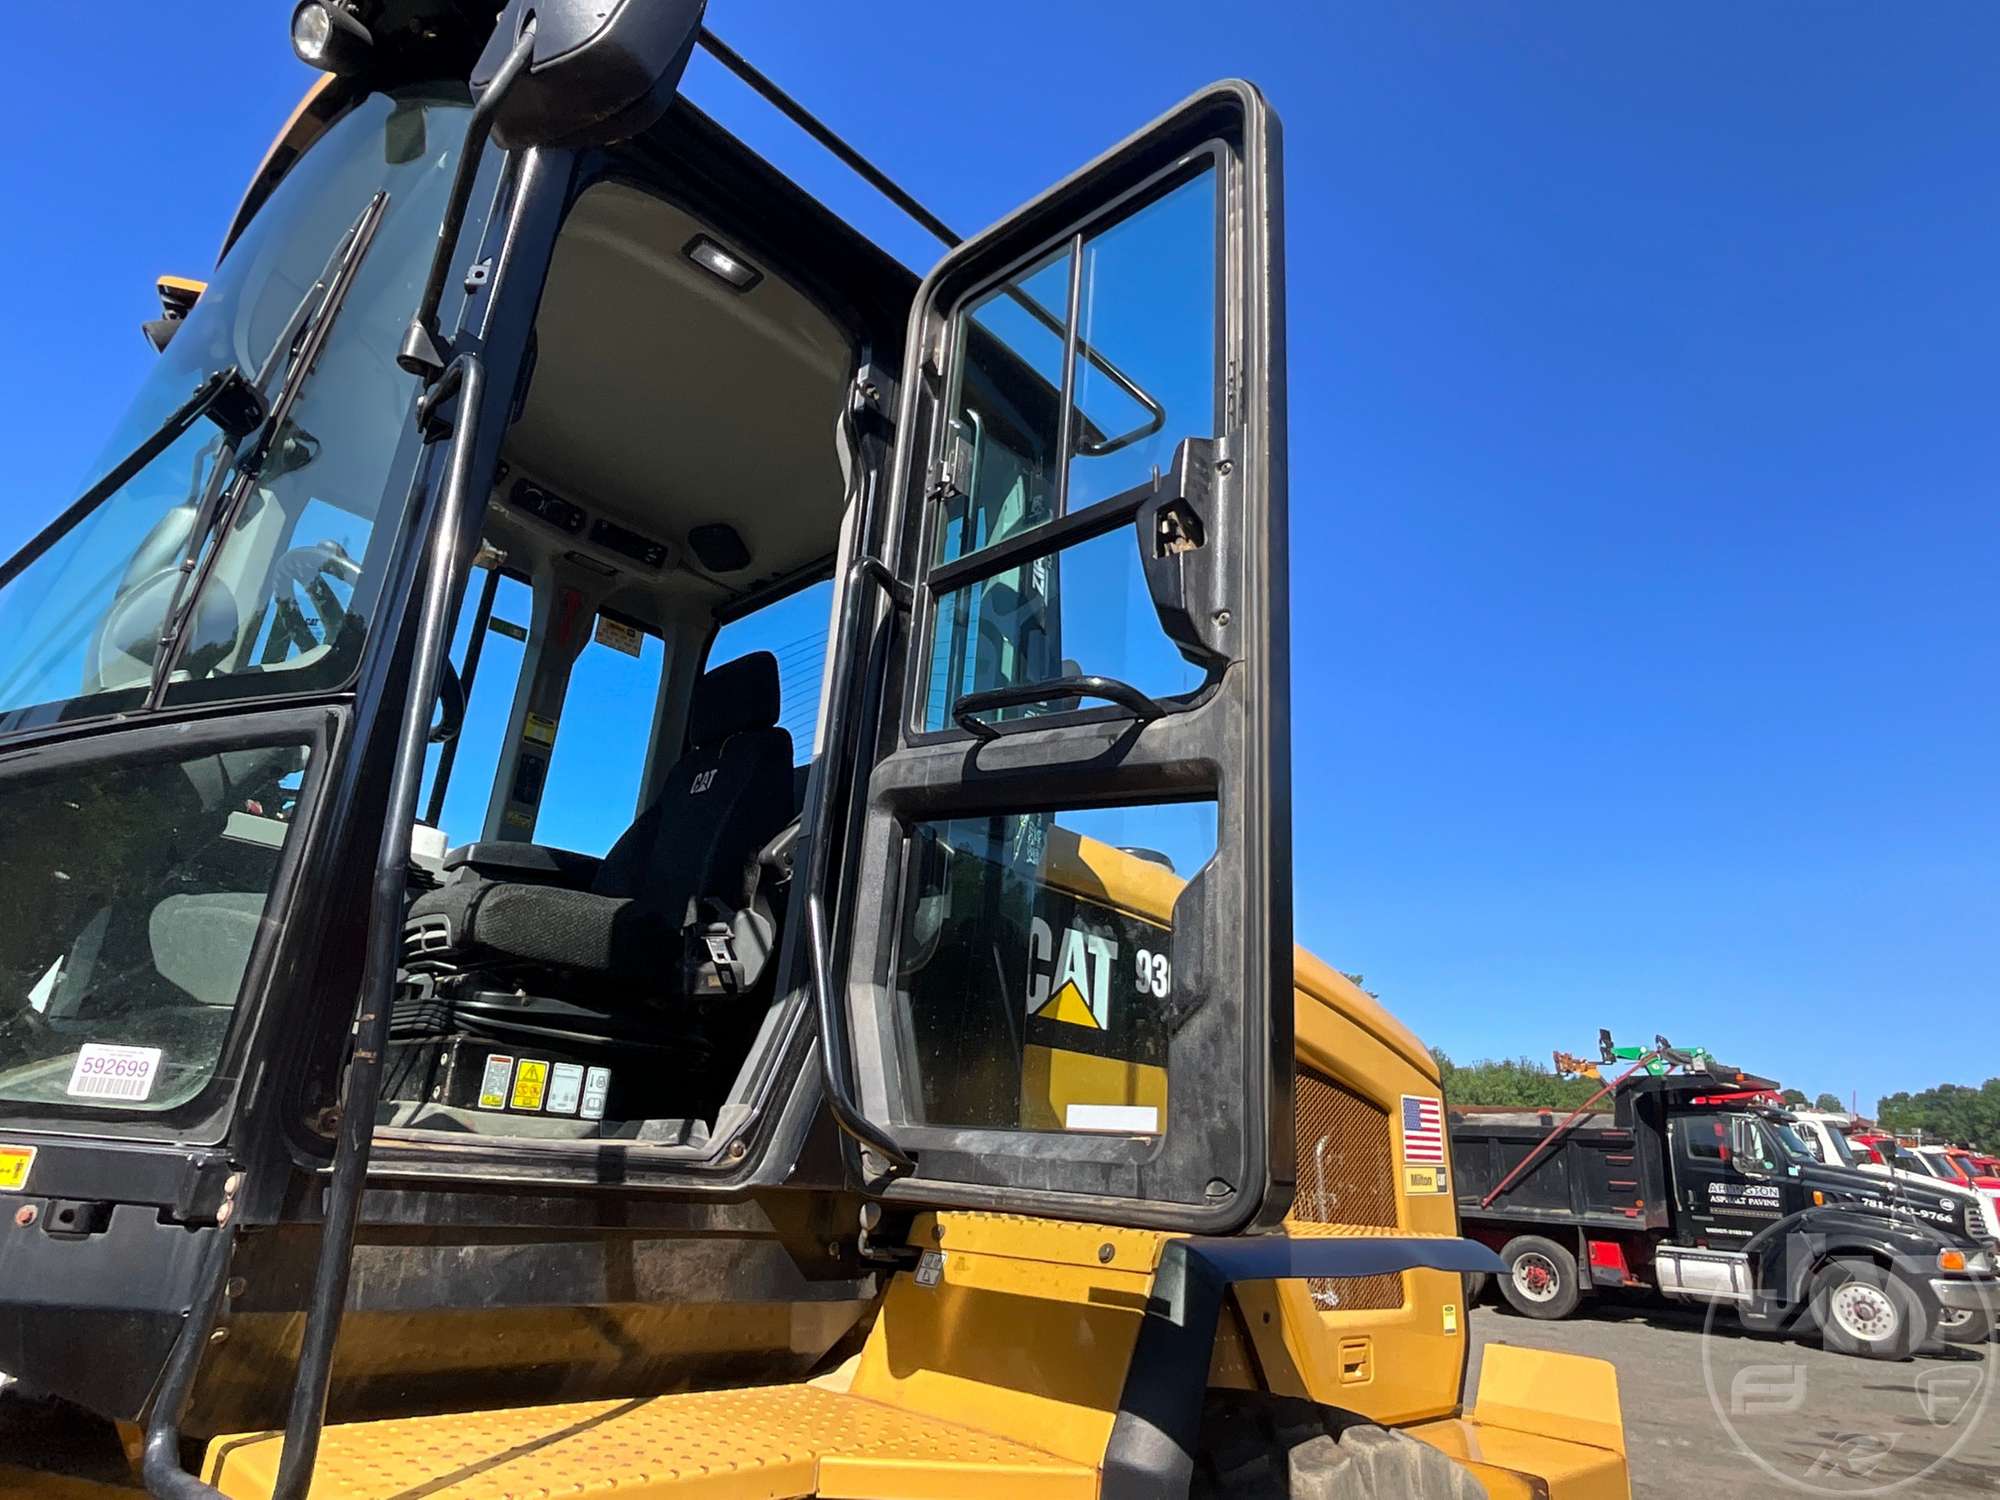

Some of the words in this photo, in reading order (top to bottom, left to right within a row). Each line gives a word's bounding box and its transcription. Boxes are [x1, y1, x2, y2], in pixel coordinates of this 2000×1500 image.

[689, 769, 718, 794] CAT
[1026, 916, 1119, 1031] CAT
[1135, 949, 1171, 998] 93
[81, 1057, 149, 1078] 592699
[1410, 1173, 1433, 1187] Milton
[1748, 1198, 1780, 1208] PAVING
